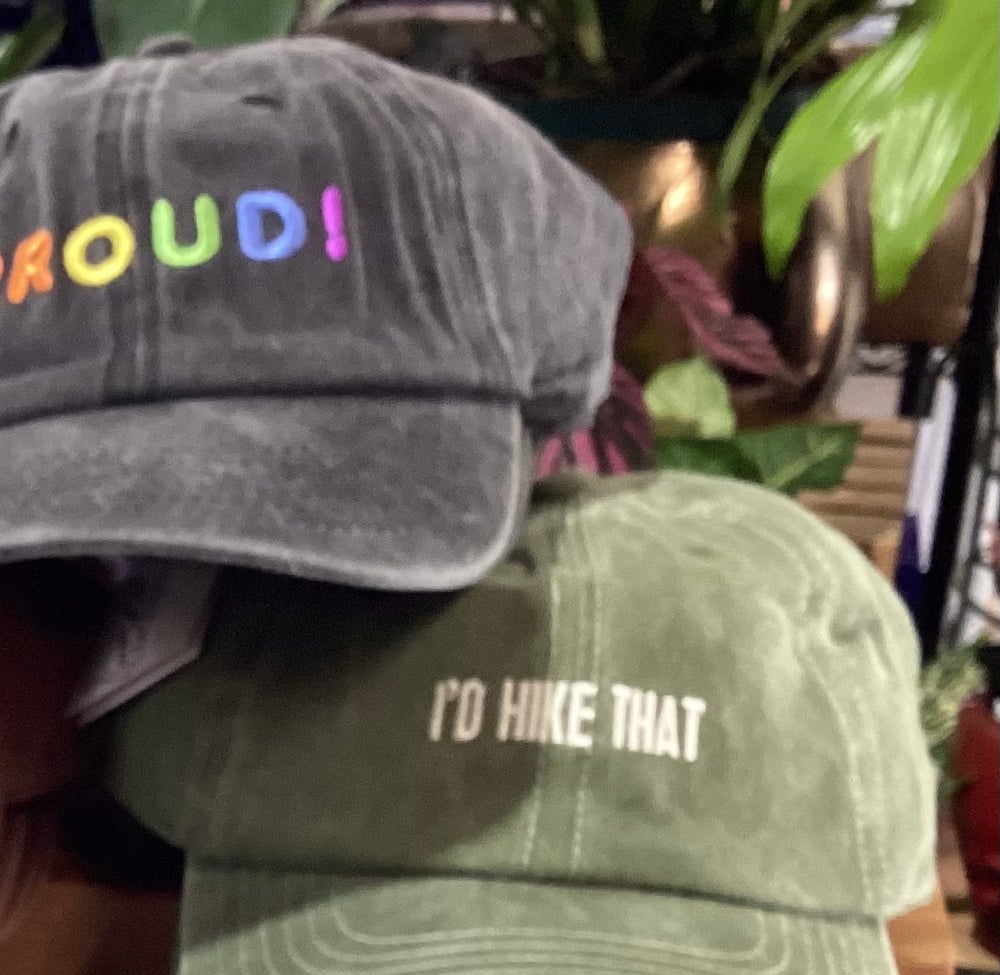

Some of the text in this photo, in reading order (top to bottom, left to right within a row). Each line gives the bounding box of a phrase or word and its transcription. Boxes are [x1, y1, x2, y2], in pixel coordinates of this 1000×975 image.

[428, 675, 707, 763] I'D HIKE THAT
